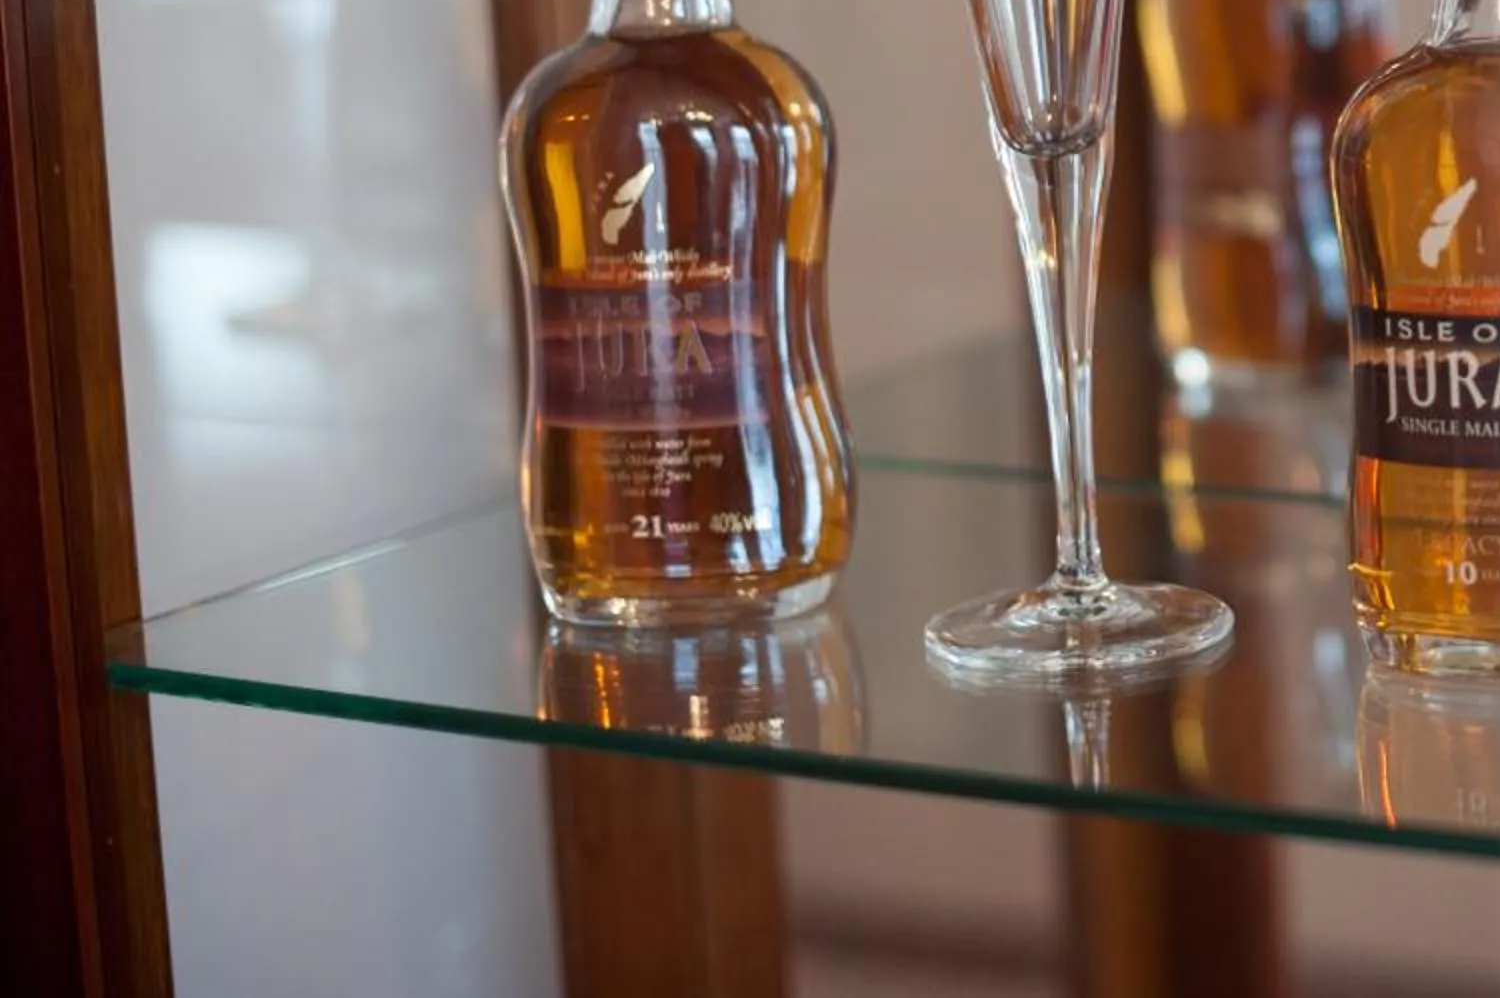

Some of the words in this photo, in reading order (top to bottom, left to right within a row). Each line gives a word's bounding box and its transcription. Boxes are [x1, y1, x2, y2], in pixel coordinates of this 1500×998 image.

[1385, 318, 1455, 342] ISLE
[1401, 416, 1460, 435] SINGLE
[631, 513, 665, 539] 21
[1446, 560, 1478, 586] 10
